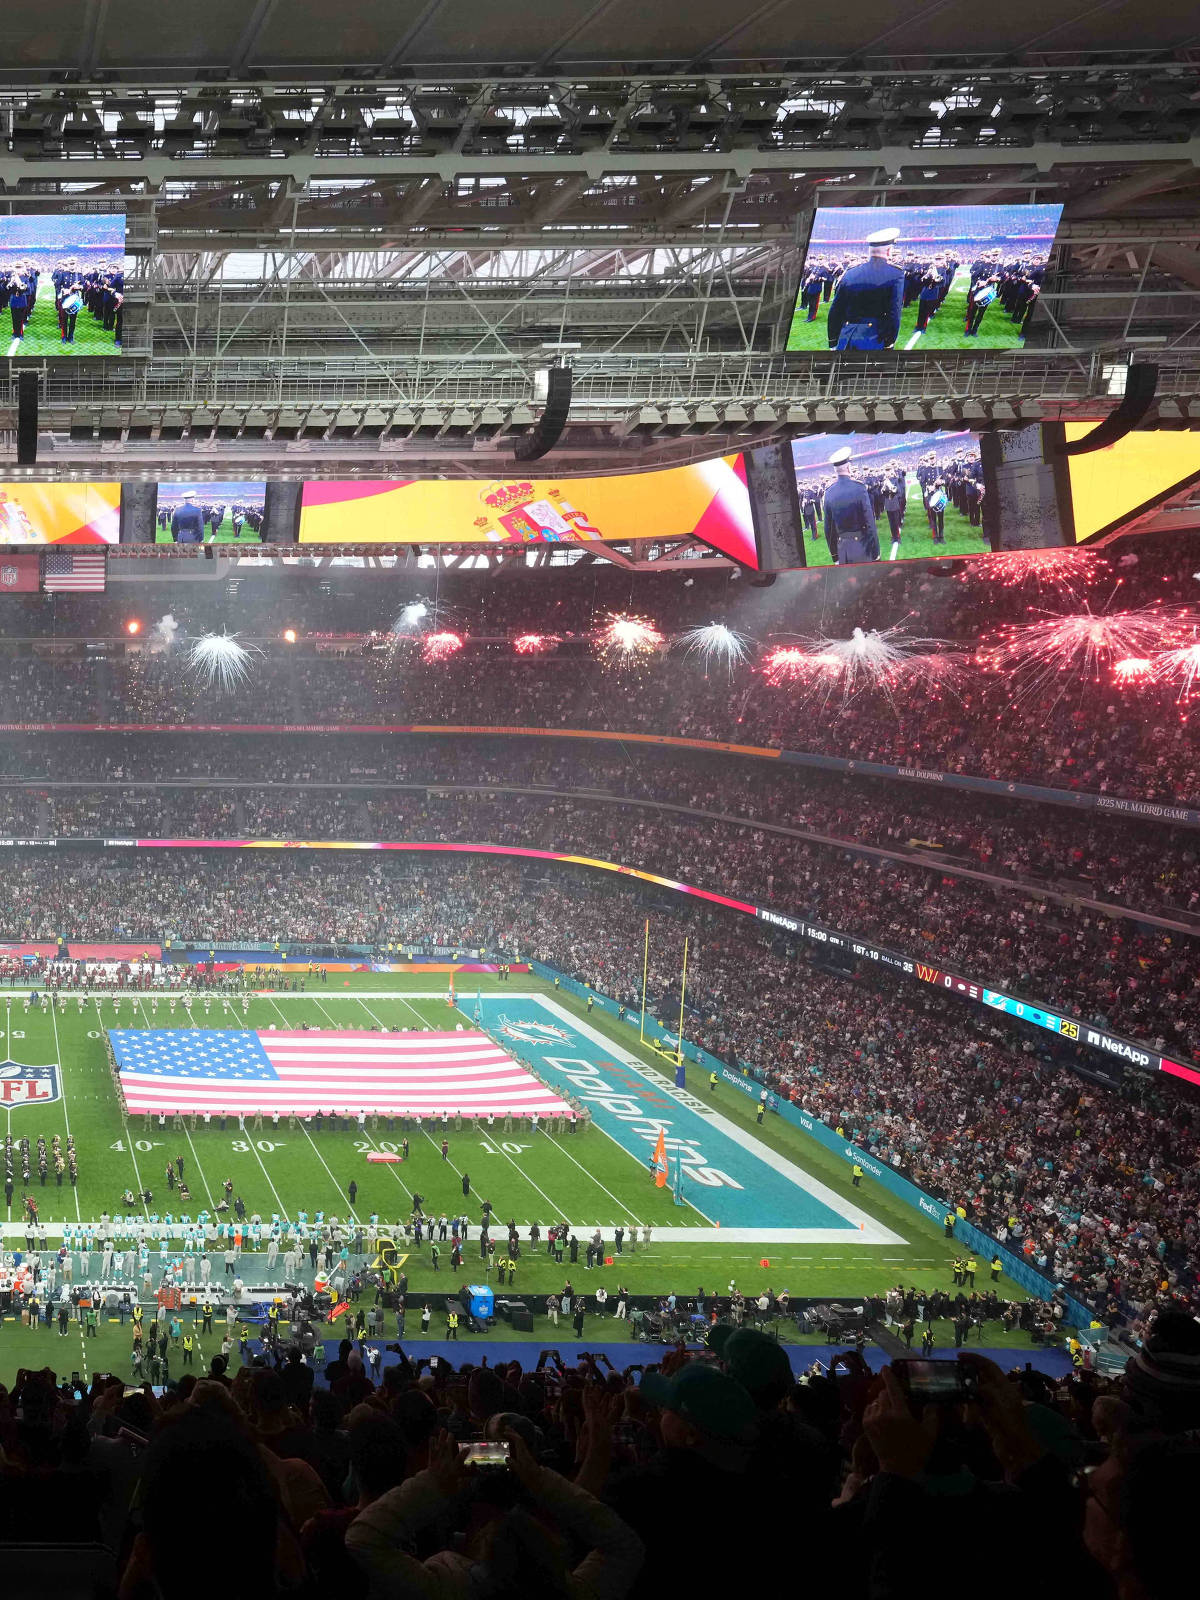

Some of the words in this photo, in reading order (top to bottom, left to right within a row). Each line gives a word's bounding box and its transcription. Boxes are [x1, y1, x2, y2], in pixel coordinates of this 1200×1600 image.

[897, 768, 915, 777] MIAMI
[916, 771, 944, 781] DOLPHINS
[1115, 801, 1130, 811] NFL
[1130, 803, 1164, 816] MADRID
[1164, 808, 1189, 820] GAME
[769, 913, 798, 932] NetApp
[807, 928, 827, 942] 15:00
[852, 944, 866, 956] 1ST
[869, 949, 879, 961] 10
[902, 961, 913, 973] 35
[944, 976, 952, 988] 0
[1016, 1003, 1024, 1016] 0
[1060, 1021, 1077, 1038] 25
[1101, 1036, 1150, 1067] NetApp
[594, 1060, 677, 1110] MIAMI
[627, 1061, 658, 1081] END
[656, 1079, 715, 1116] RACISM
[722, 1068, 753, 1092] Dolphins
[541, 1056, 745, 1190] Dolphins
[800, 1116, 813, 1131] VISA
[109, 1140, 153, 1152] 40
[231, 1140, 276, 1152] 30
[352, 1141, 399, 1153] 20
[479, 1141, 523, 1154] 10
[852, 1152, 882, 1177] Santander
